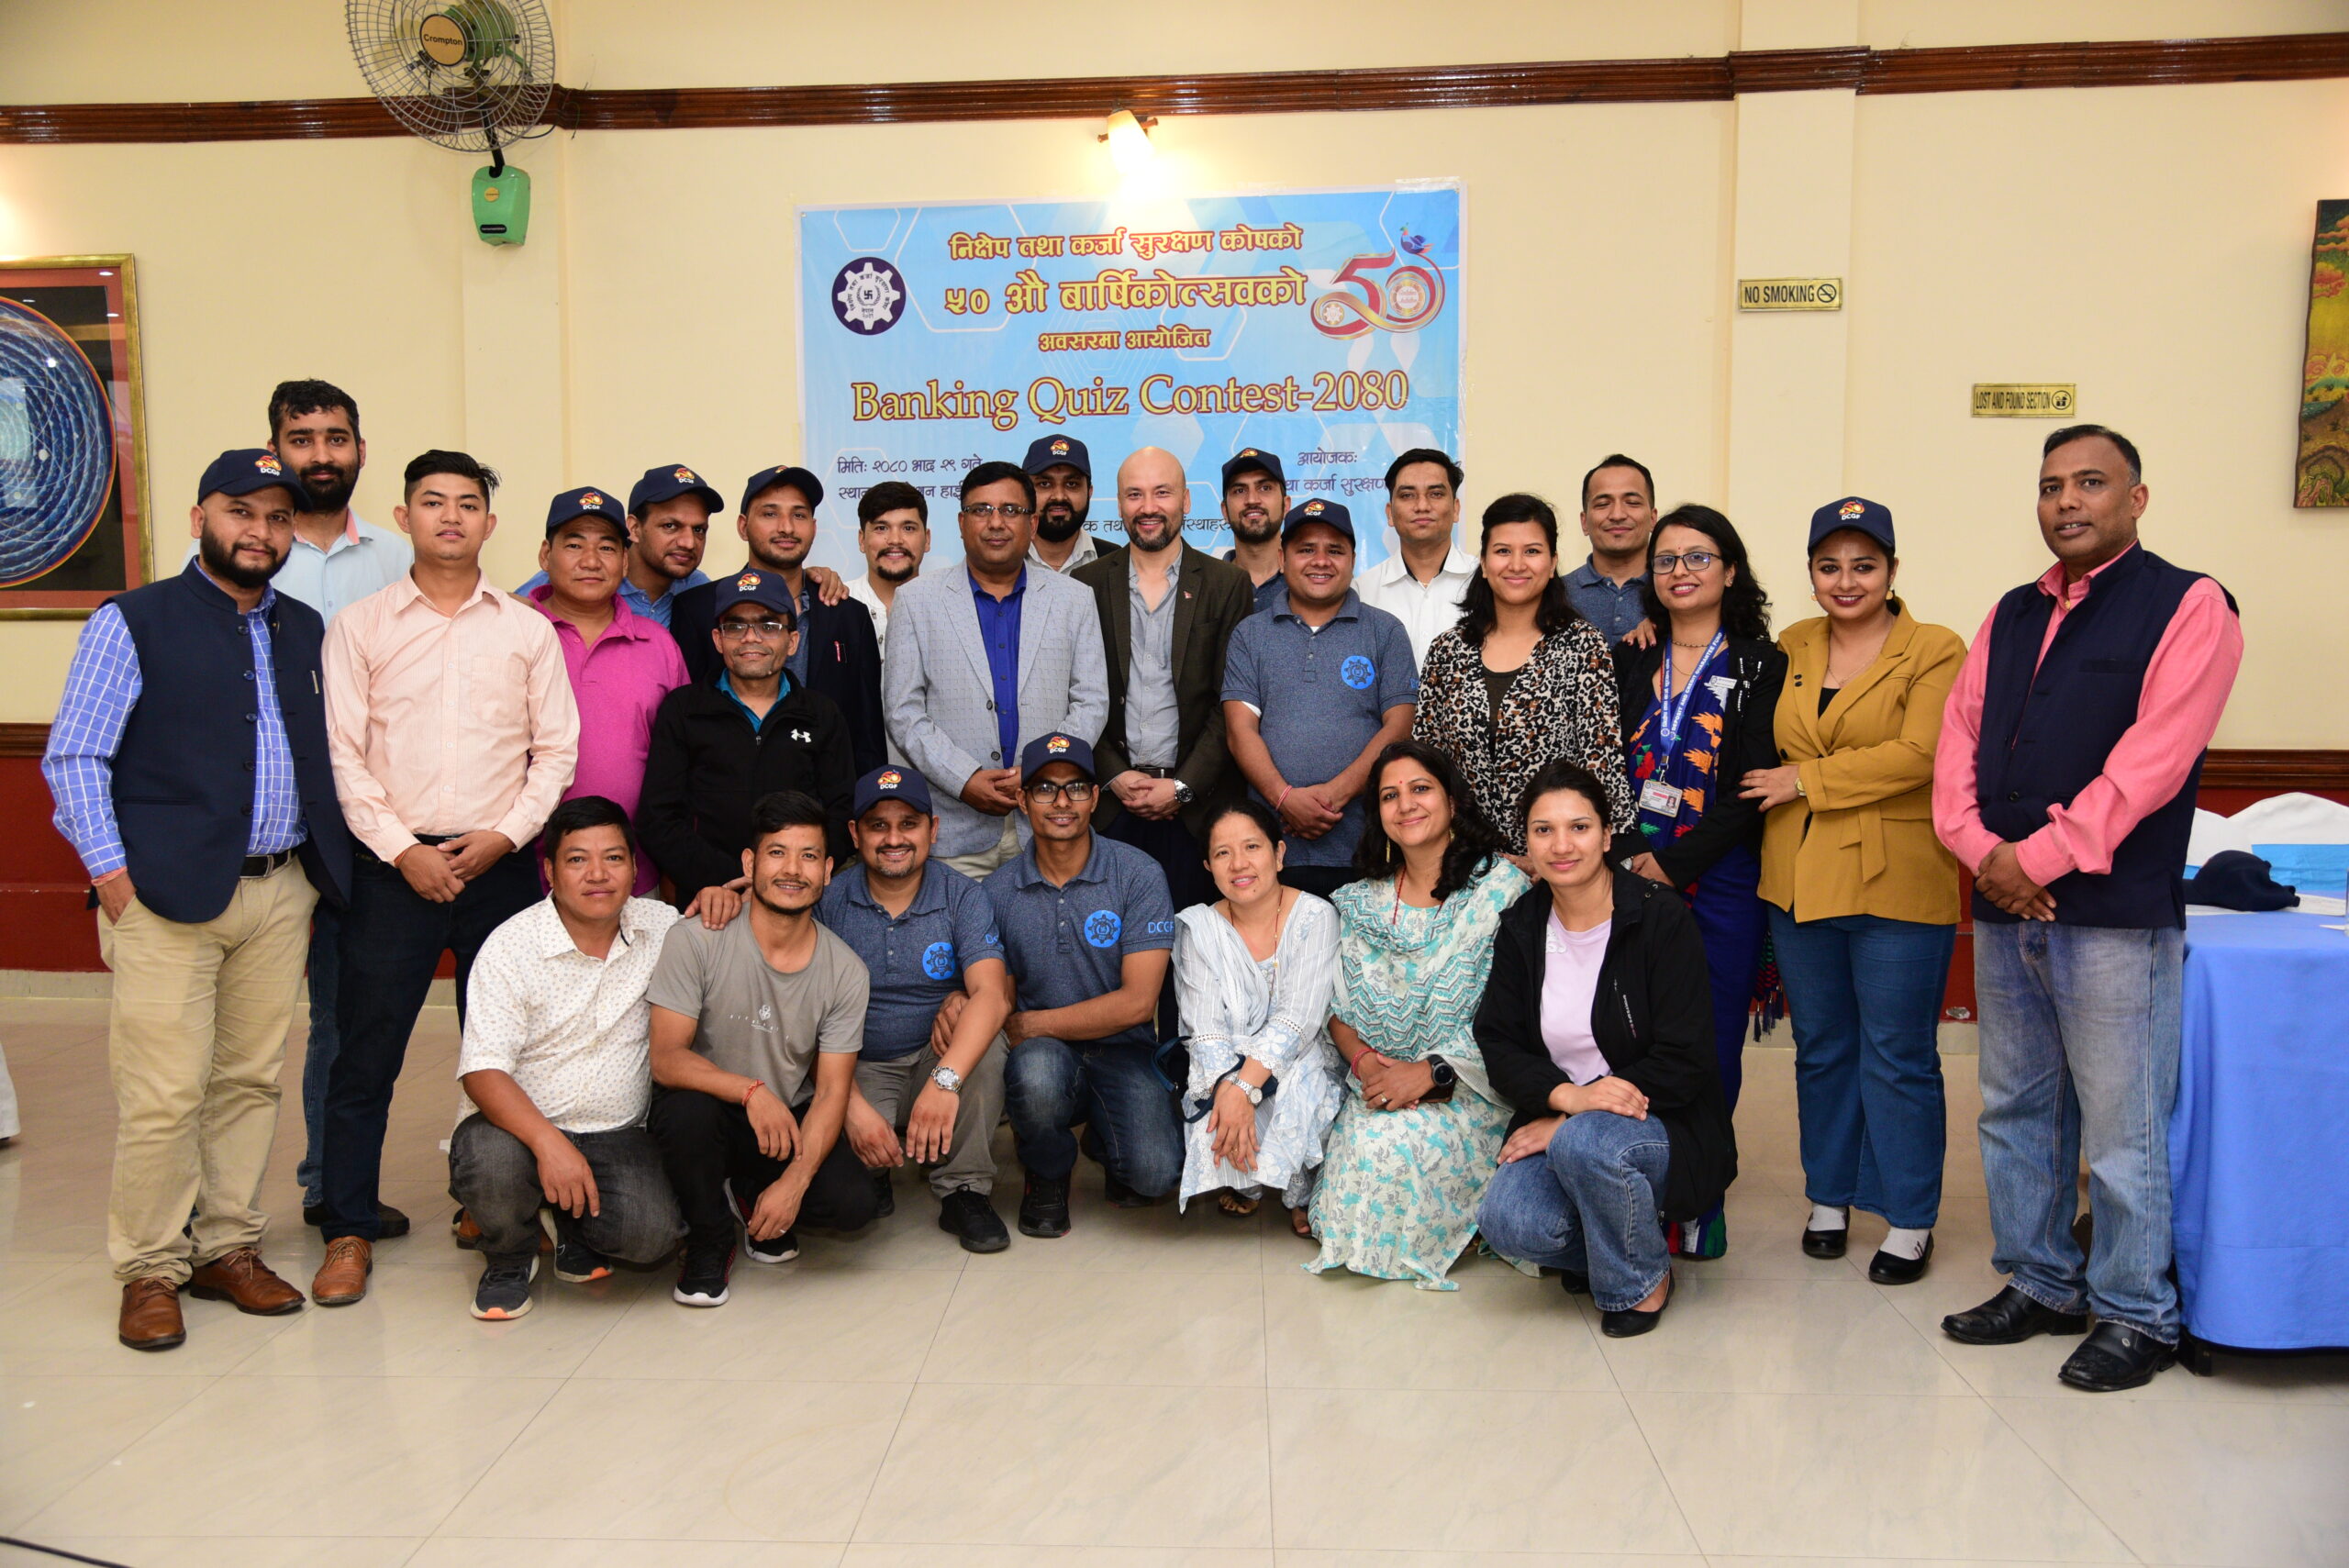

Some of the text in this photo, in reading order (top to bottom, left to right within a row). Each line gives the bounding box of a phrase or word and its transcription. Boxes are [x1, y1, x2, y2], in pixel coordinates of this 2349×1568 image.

[423, 33, 463, 46] Crompton
[948, 222, 1304, 261] निक्षेप तथा कर्जा सुरक्षण कोषको
[944, 266, 1308, 315] ५० औ बार्षिकोत्सवको
[1744, 284, 1815, 304] NO SMOKING
[1039, 323, 1211, 352] अवसरमा आयोजित
[851, 370, 1409, 431] Banking Quiz Contest-2080
[1976, 392, 2050, 409] LOST AND FOUND SECTION
[873, 460, 907, 473] २०८०
[1304, 473, 1337, 492] कर्जा
[1671, 706, 1683, 731] DEPOSIT
[1680, 694, 1688, 706] AND
[1685, 674, 1697, 693] CREDIT
[1695, 645, 1715, 674] GUARANTEE
